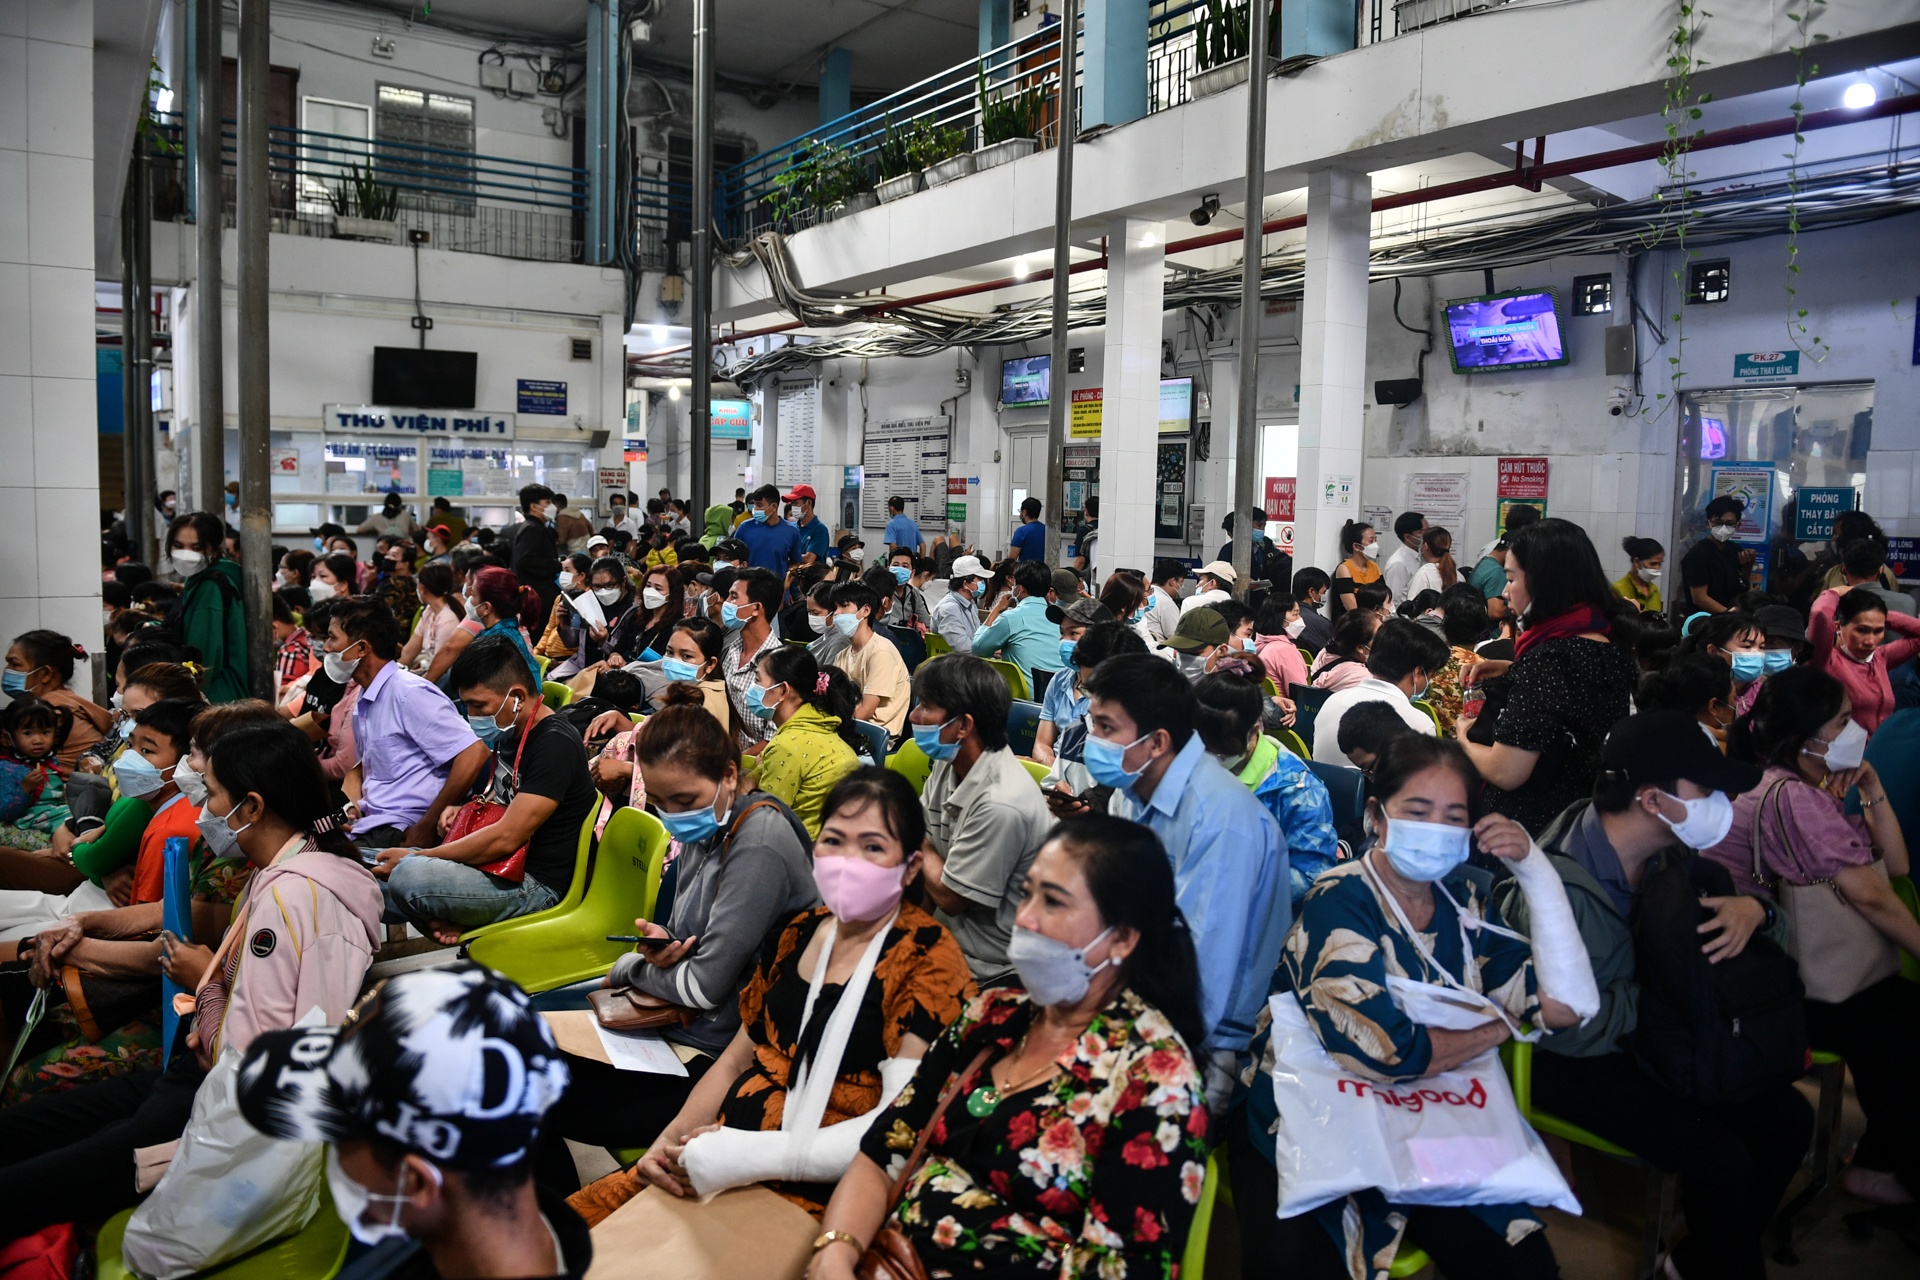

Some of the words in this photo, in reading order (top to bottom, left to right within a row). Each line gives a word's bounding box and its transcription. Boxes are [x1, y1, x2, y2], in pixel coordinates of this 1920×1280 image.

[1480, 336, 1498, 345] THOÁI
[1499, 335, 1511, 343] HÓA
[1740, 366, 1759, 376] PHÒNG
[1760, 367, 1775, 375] THAY
[1776, 365, 1792, 374] BĂNG
[1080, 391, 1094, 401] PHÒNG
[393, 414, 447, 432] VIỆN
[453, 416, 490, 433] PHÍ
[495, 420, 505, 433] 1
[1500, 461, 1513, 473] CẤM
[1514, 461, 1525, 473] HÚT
[1527, 461, 1545, 473] THUỐC
[1520, 475, 1545, 484] Smoking
[1273, 483, 1290, 493] KHU
[1811, 491, 1839, 504] PHÒNG
[1267, 499, 1278, 518] HẠN
[1279, 493, 1291, 516] CHẾ
[1801, 509, 1823, 519] THAY
[1898, 540, 1913, 548] LÒNG
[1890, 550, 1899, 560] SỐ
[1899, 552, 1909, 561] TẠI
